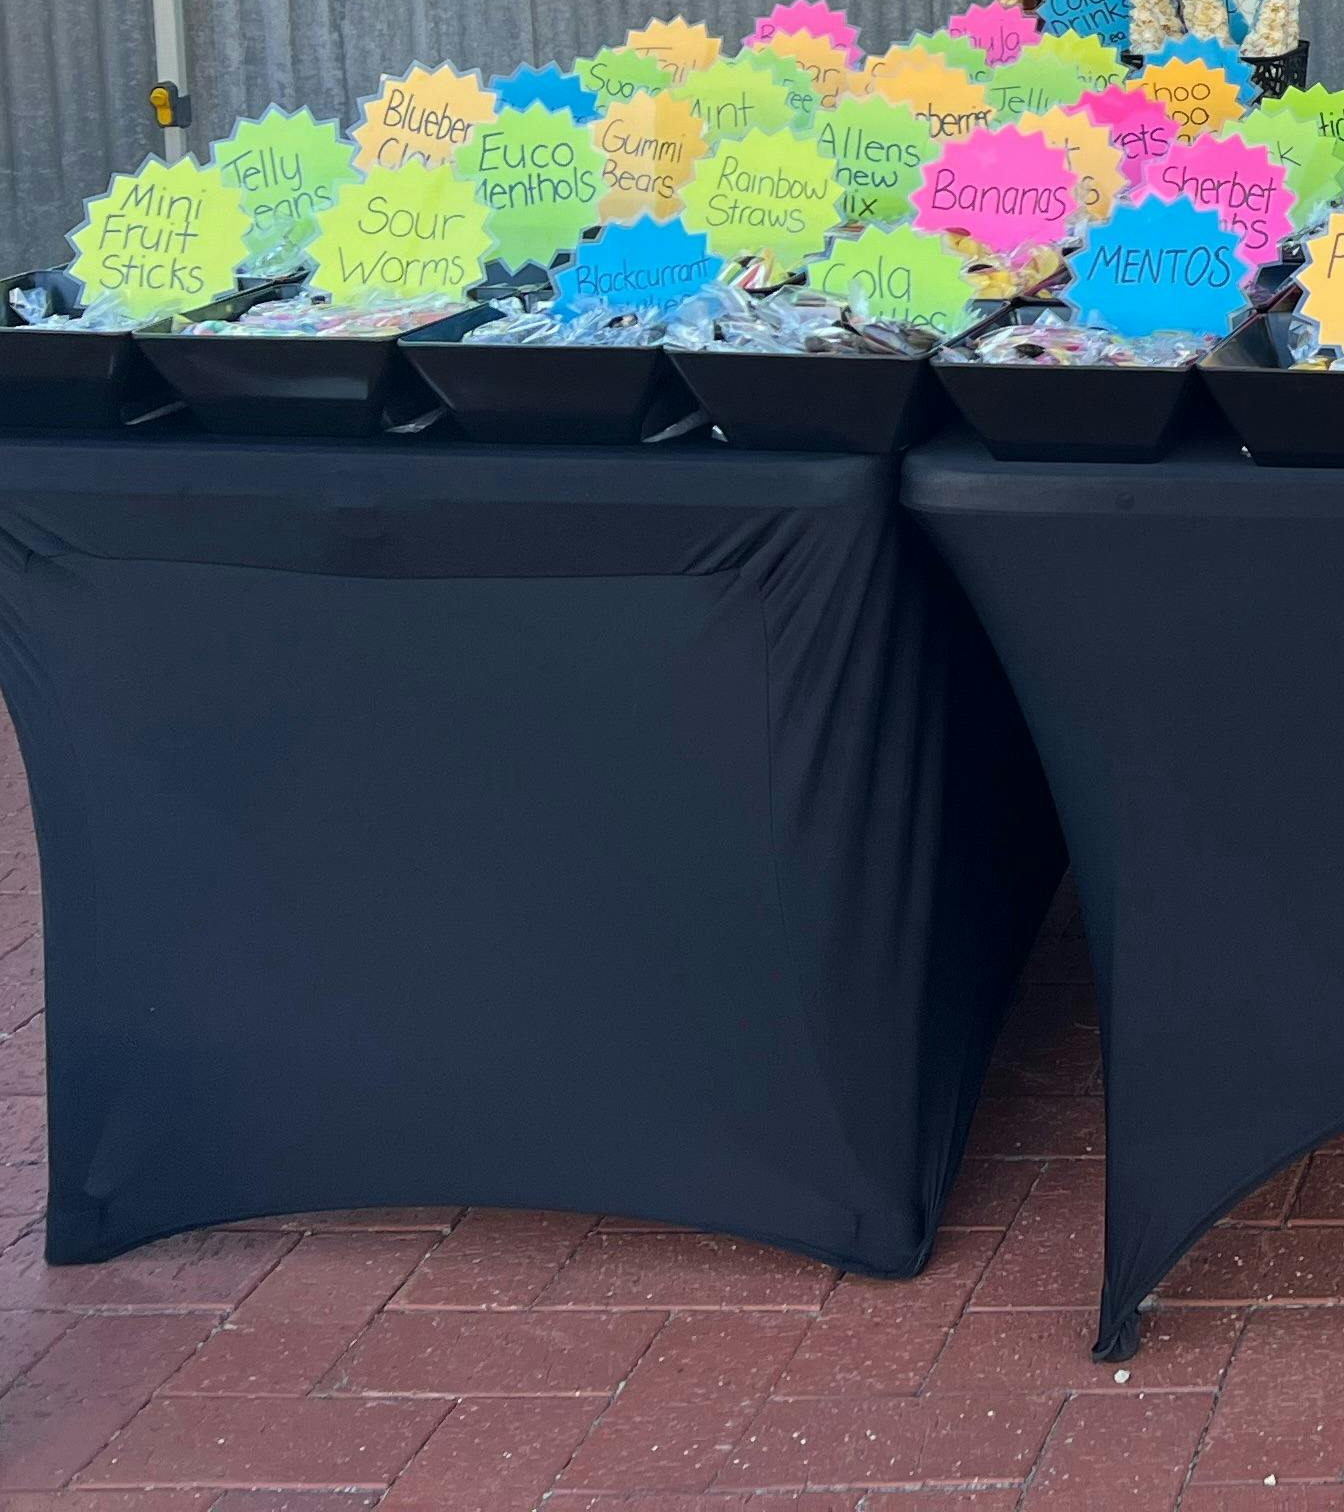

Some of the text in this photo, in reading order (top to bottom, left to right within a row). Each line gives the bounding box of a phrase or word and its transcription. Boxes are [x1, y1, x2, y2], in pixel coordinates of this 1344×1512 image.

[479, 131, 574, 172] Euco
[602, 119, 686, 163] Gummi
[819, 123, 921, 168] Allens
[602, 159, 675, 199] Bears
[716, 156, 829, 200] Rainbow
[836, 167, 898, 188] new
[931, 168, 1068, 221] Bananas
[1162, 165, 1277, 215] Sherbet
[120, 184, 206, 221] Mini
[246, 185, 333, 236] eans
[358, 196, 466, 240] Sour
[705, 194, 806, 233] Straws
[99, 214, 199, 254] Fruit
[99, 254, 205, 294] Sticks
[338, 246, 466, 286] Worms
[576, 258, 712, 296] Blackcurrant
[1087, 244, 1233, 289] MENTOS
